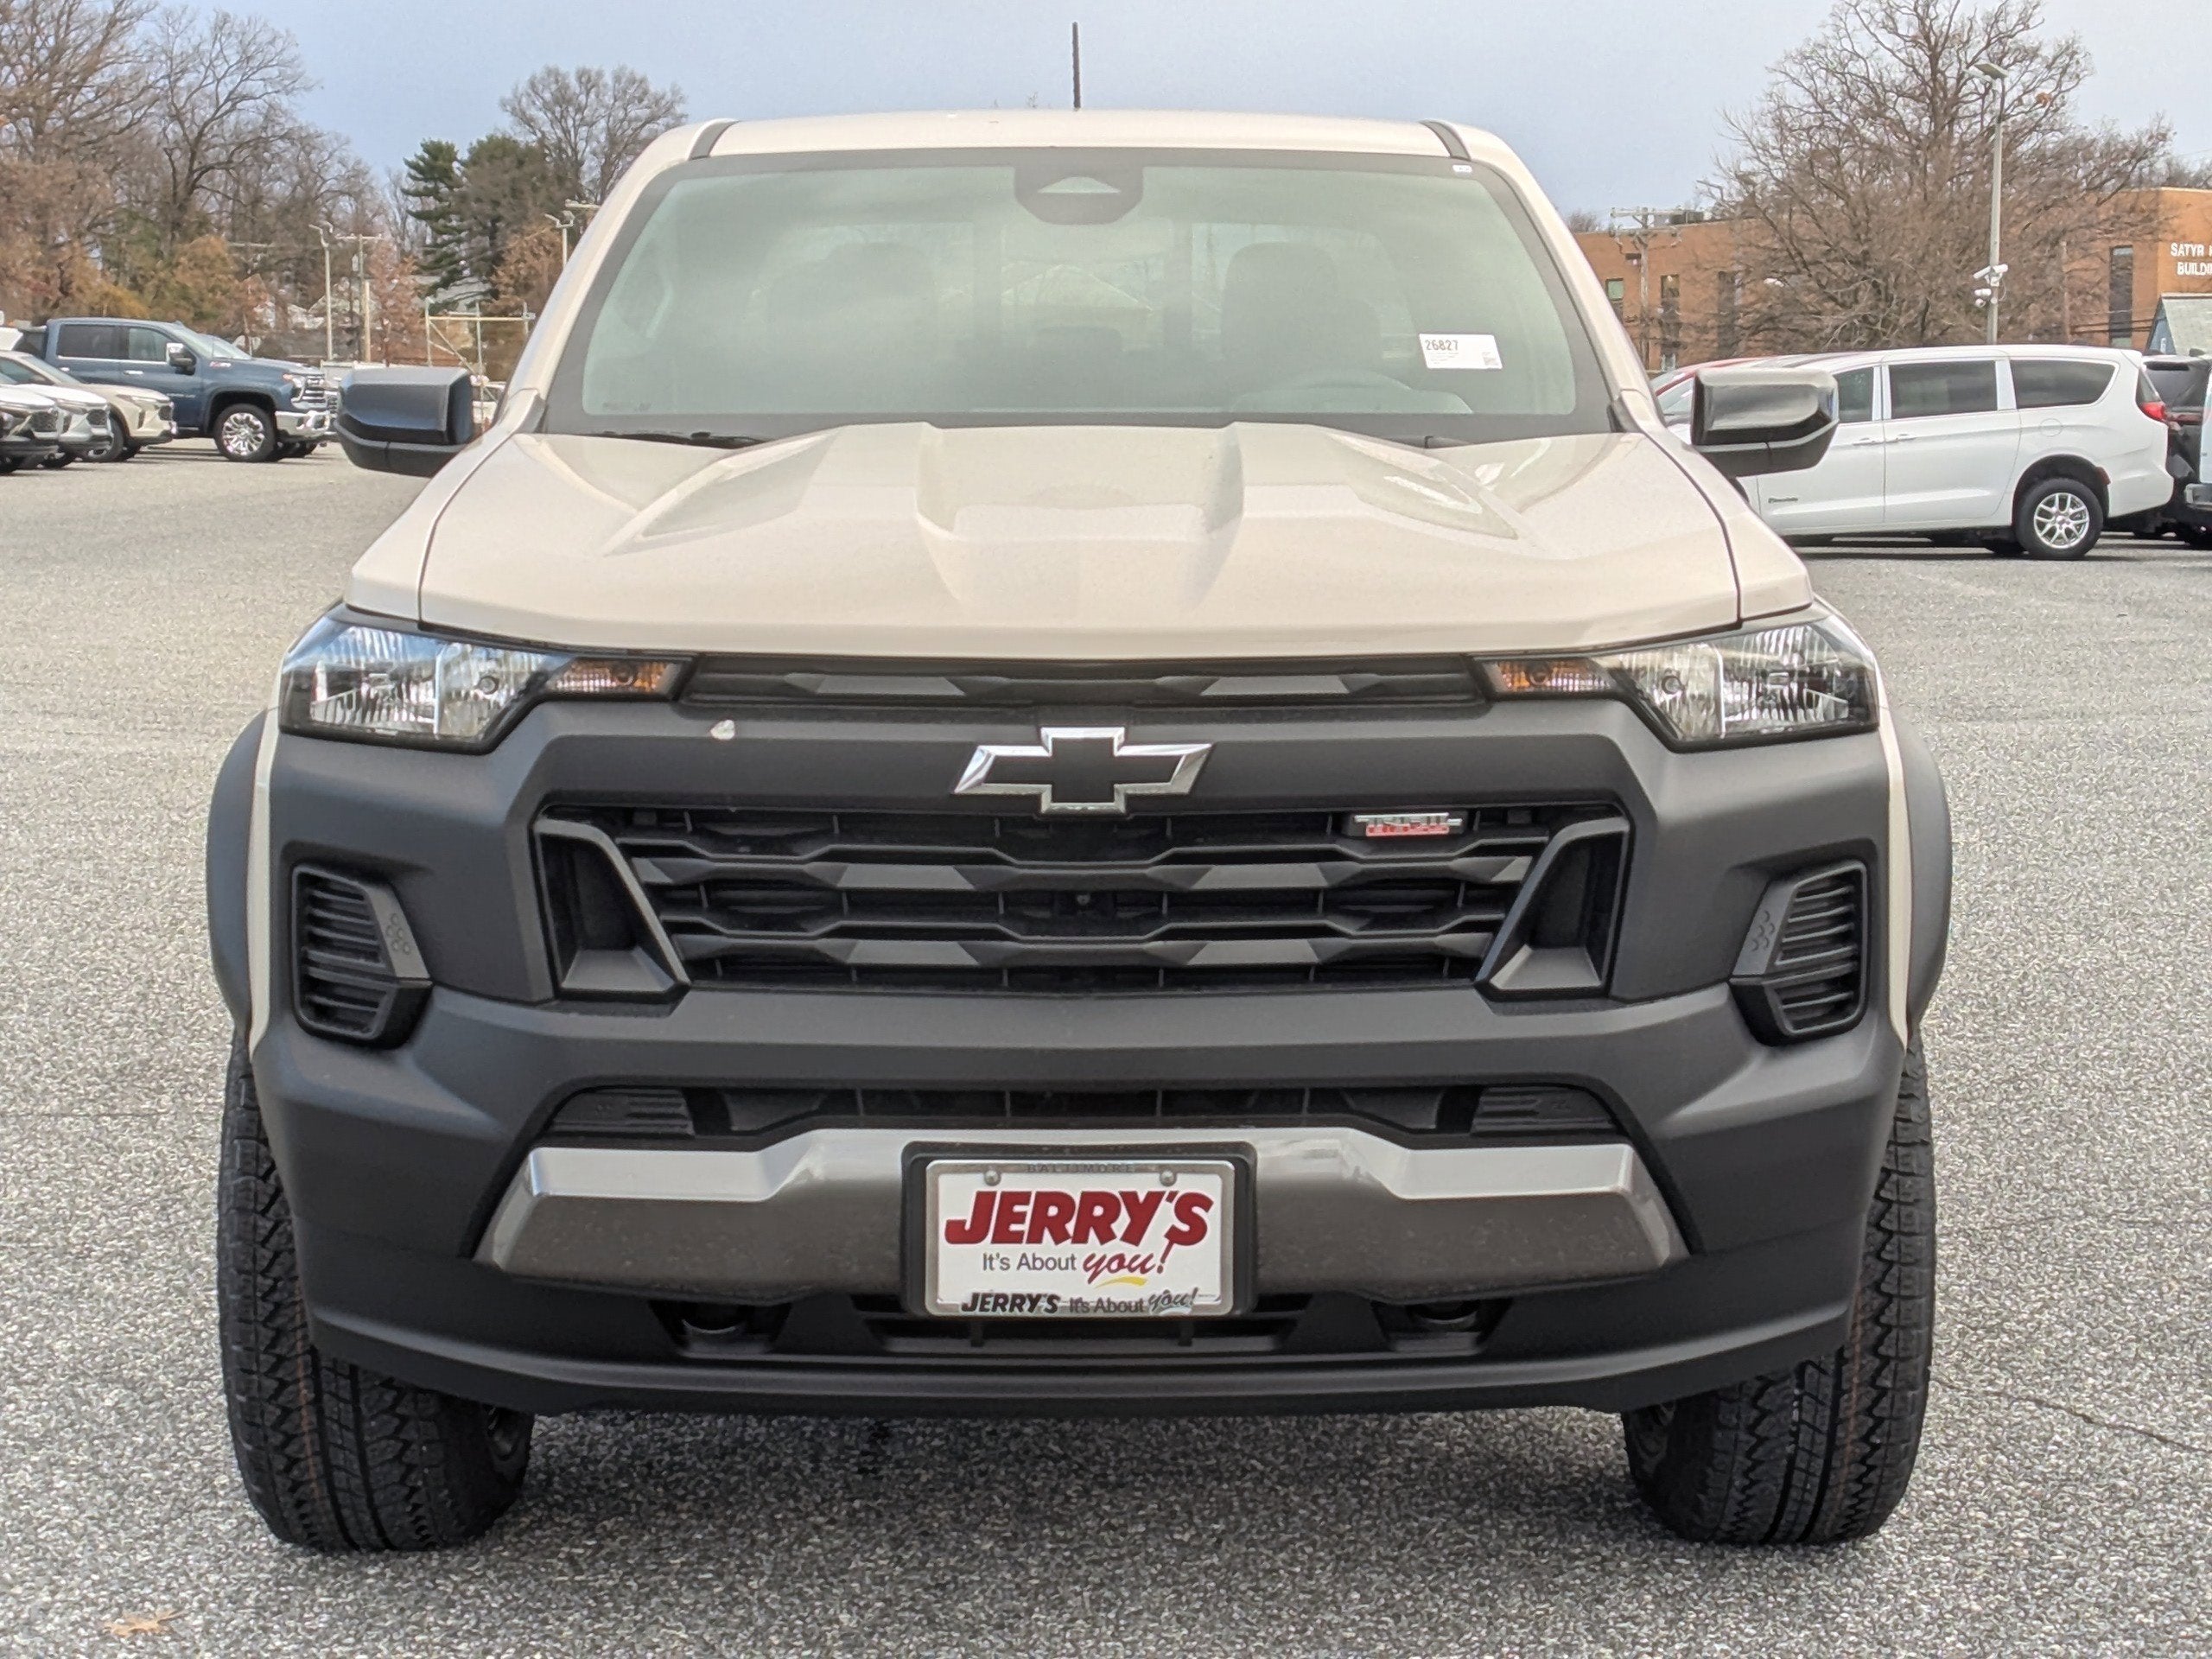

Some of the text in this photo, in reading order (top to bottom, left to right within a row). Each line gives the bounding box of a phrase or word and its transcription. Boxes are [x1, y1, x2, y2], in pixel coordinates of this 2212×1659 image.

[2170, 242, 2204, 257] SATYR
[1425, 340, 1459, 351] 26827
[1027, 1163, 1135, 1173] BALTIMORE
[944, 1191, 1214, 1246] JERRY'S
[982, 1241, 1173, 1285] It's About you!
[961, 1287, 1198, 1313] JERRY'S It's About you!
